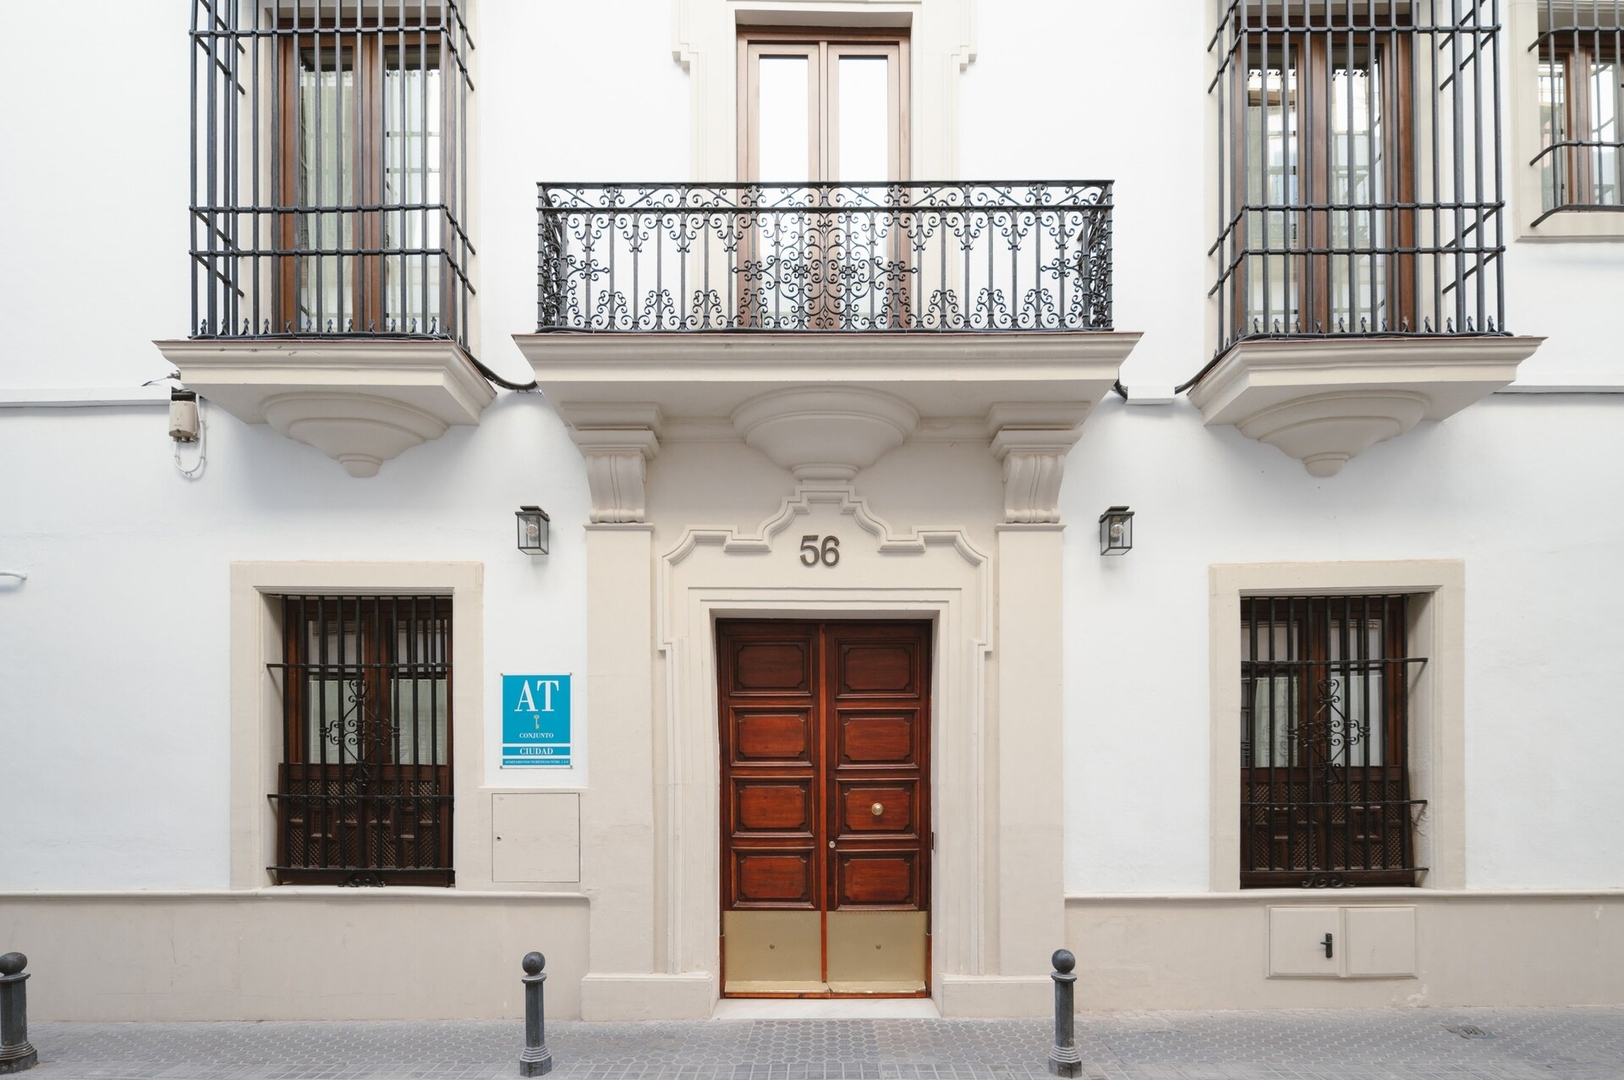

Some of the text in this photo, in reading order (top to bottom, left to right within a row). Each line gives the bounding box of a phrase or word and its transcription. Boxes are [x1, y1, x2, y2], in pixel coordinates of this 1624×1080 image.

[800, 535, 840, 567] 56
[514, 679, 560, 712] AT
[519, 747, 554, 755] CIUDAD
